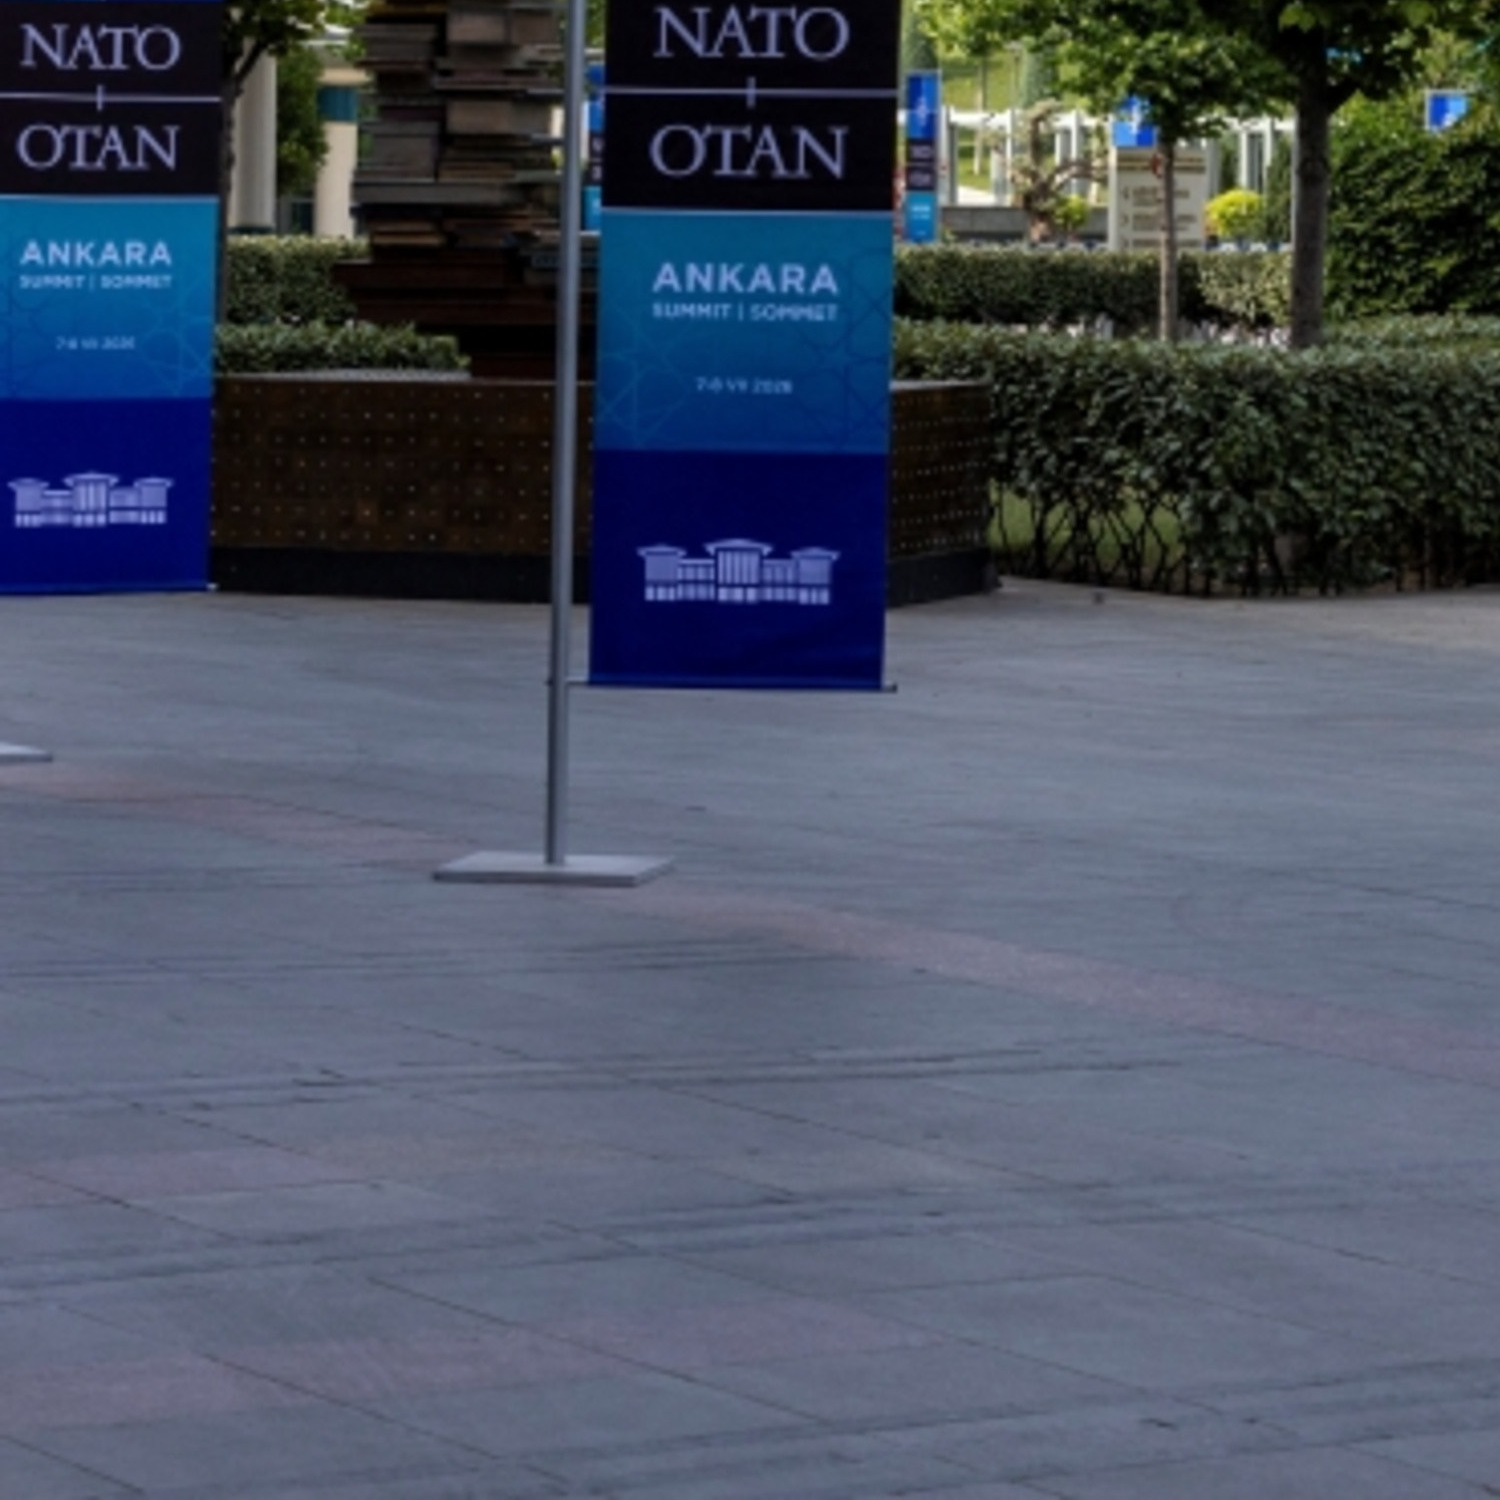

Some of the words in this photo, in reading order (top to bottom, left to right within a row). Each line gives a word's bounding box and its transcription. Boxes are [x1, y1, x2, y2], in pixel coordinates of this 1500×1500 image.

[20, 22, 182, 71] NATO
[653, 4, 851, 61] NATO
[16, 122, 180, 171] OTAN
[649, 123, 848, 180] OTAN
[19, 240, 173, 266] ANKARA
[19, 273, 86, 289] SUMMIT
[100, 273, 172, 289] SOMMET
[653, 261, 839, 295] ANKARA
[652, 302, 732, 319] SUMMIT
[749, 303, 838, 322] SOMMET
